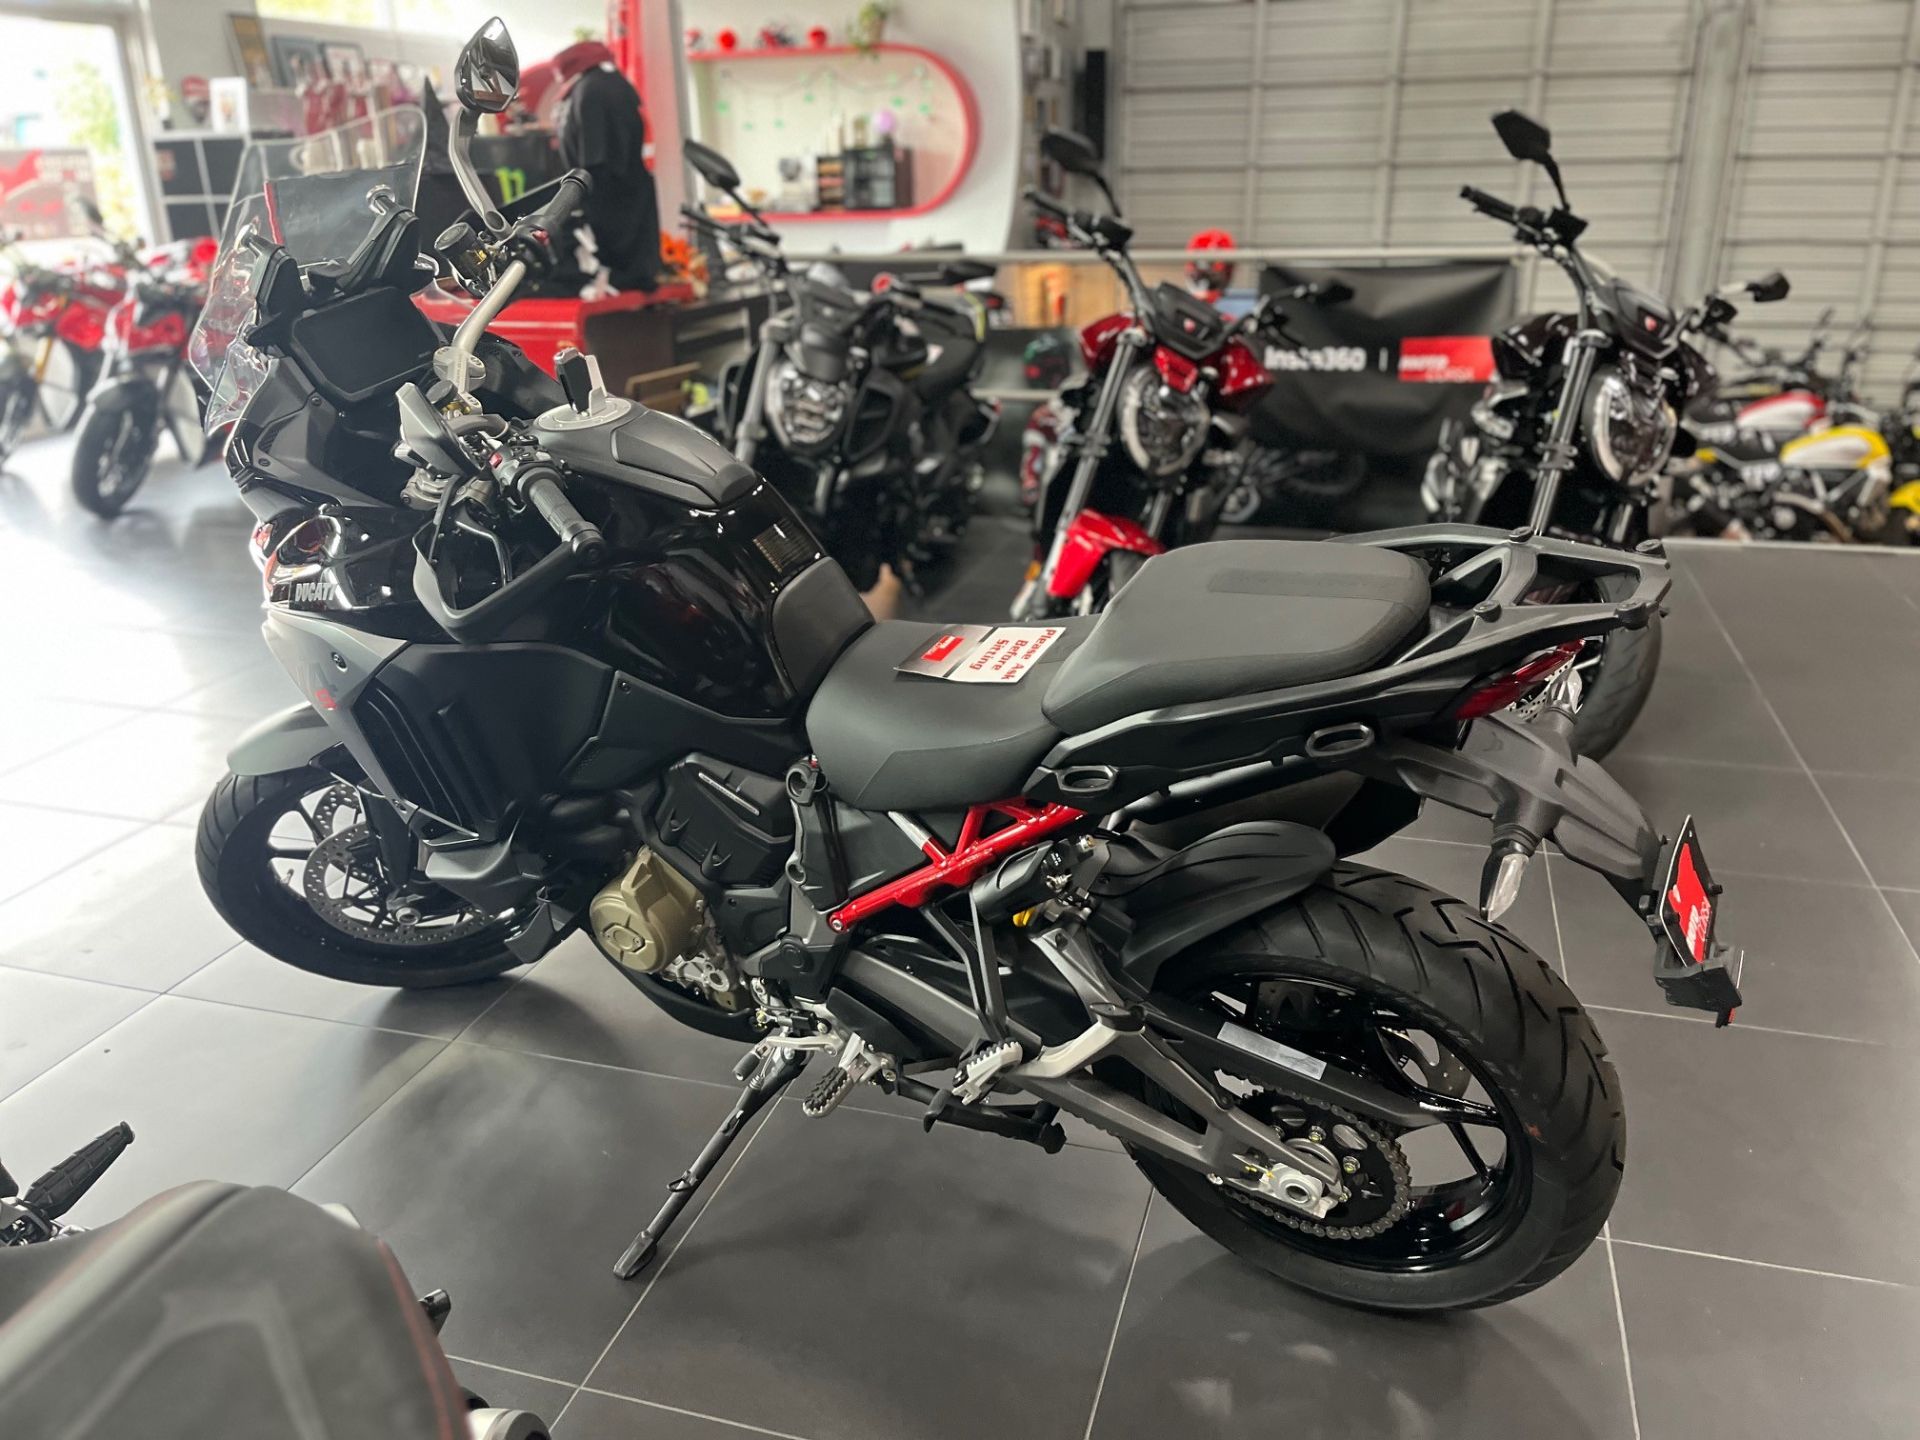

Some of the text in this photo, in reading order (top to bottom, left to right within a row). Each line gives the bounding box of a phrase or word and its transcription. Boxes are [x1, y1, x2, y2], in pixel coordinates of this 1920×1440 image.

[295, 582, 337, 602] DUCATI
[969, 639, 1010, 670] Sitting
[992, 640, 1029, 671] Before
[1001, 629, 1057, 680] Please Ask
